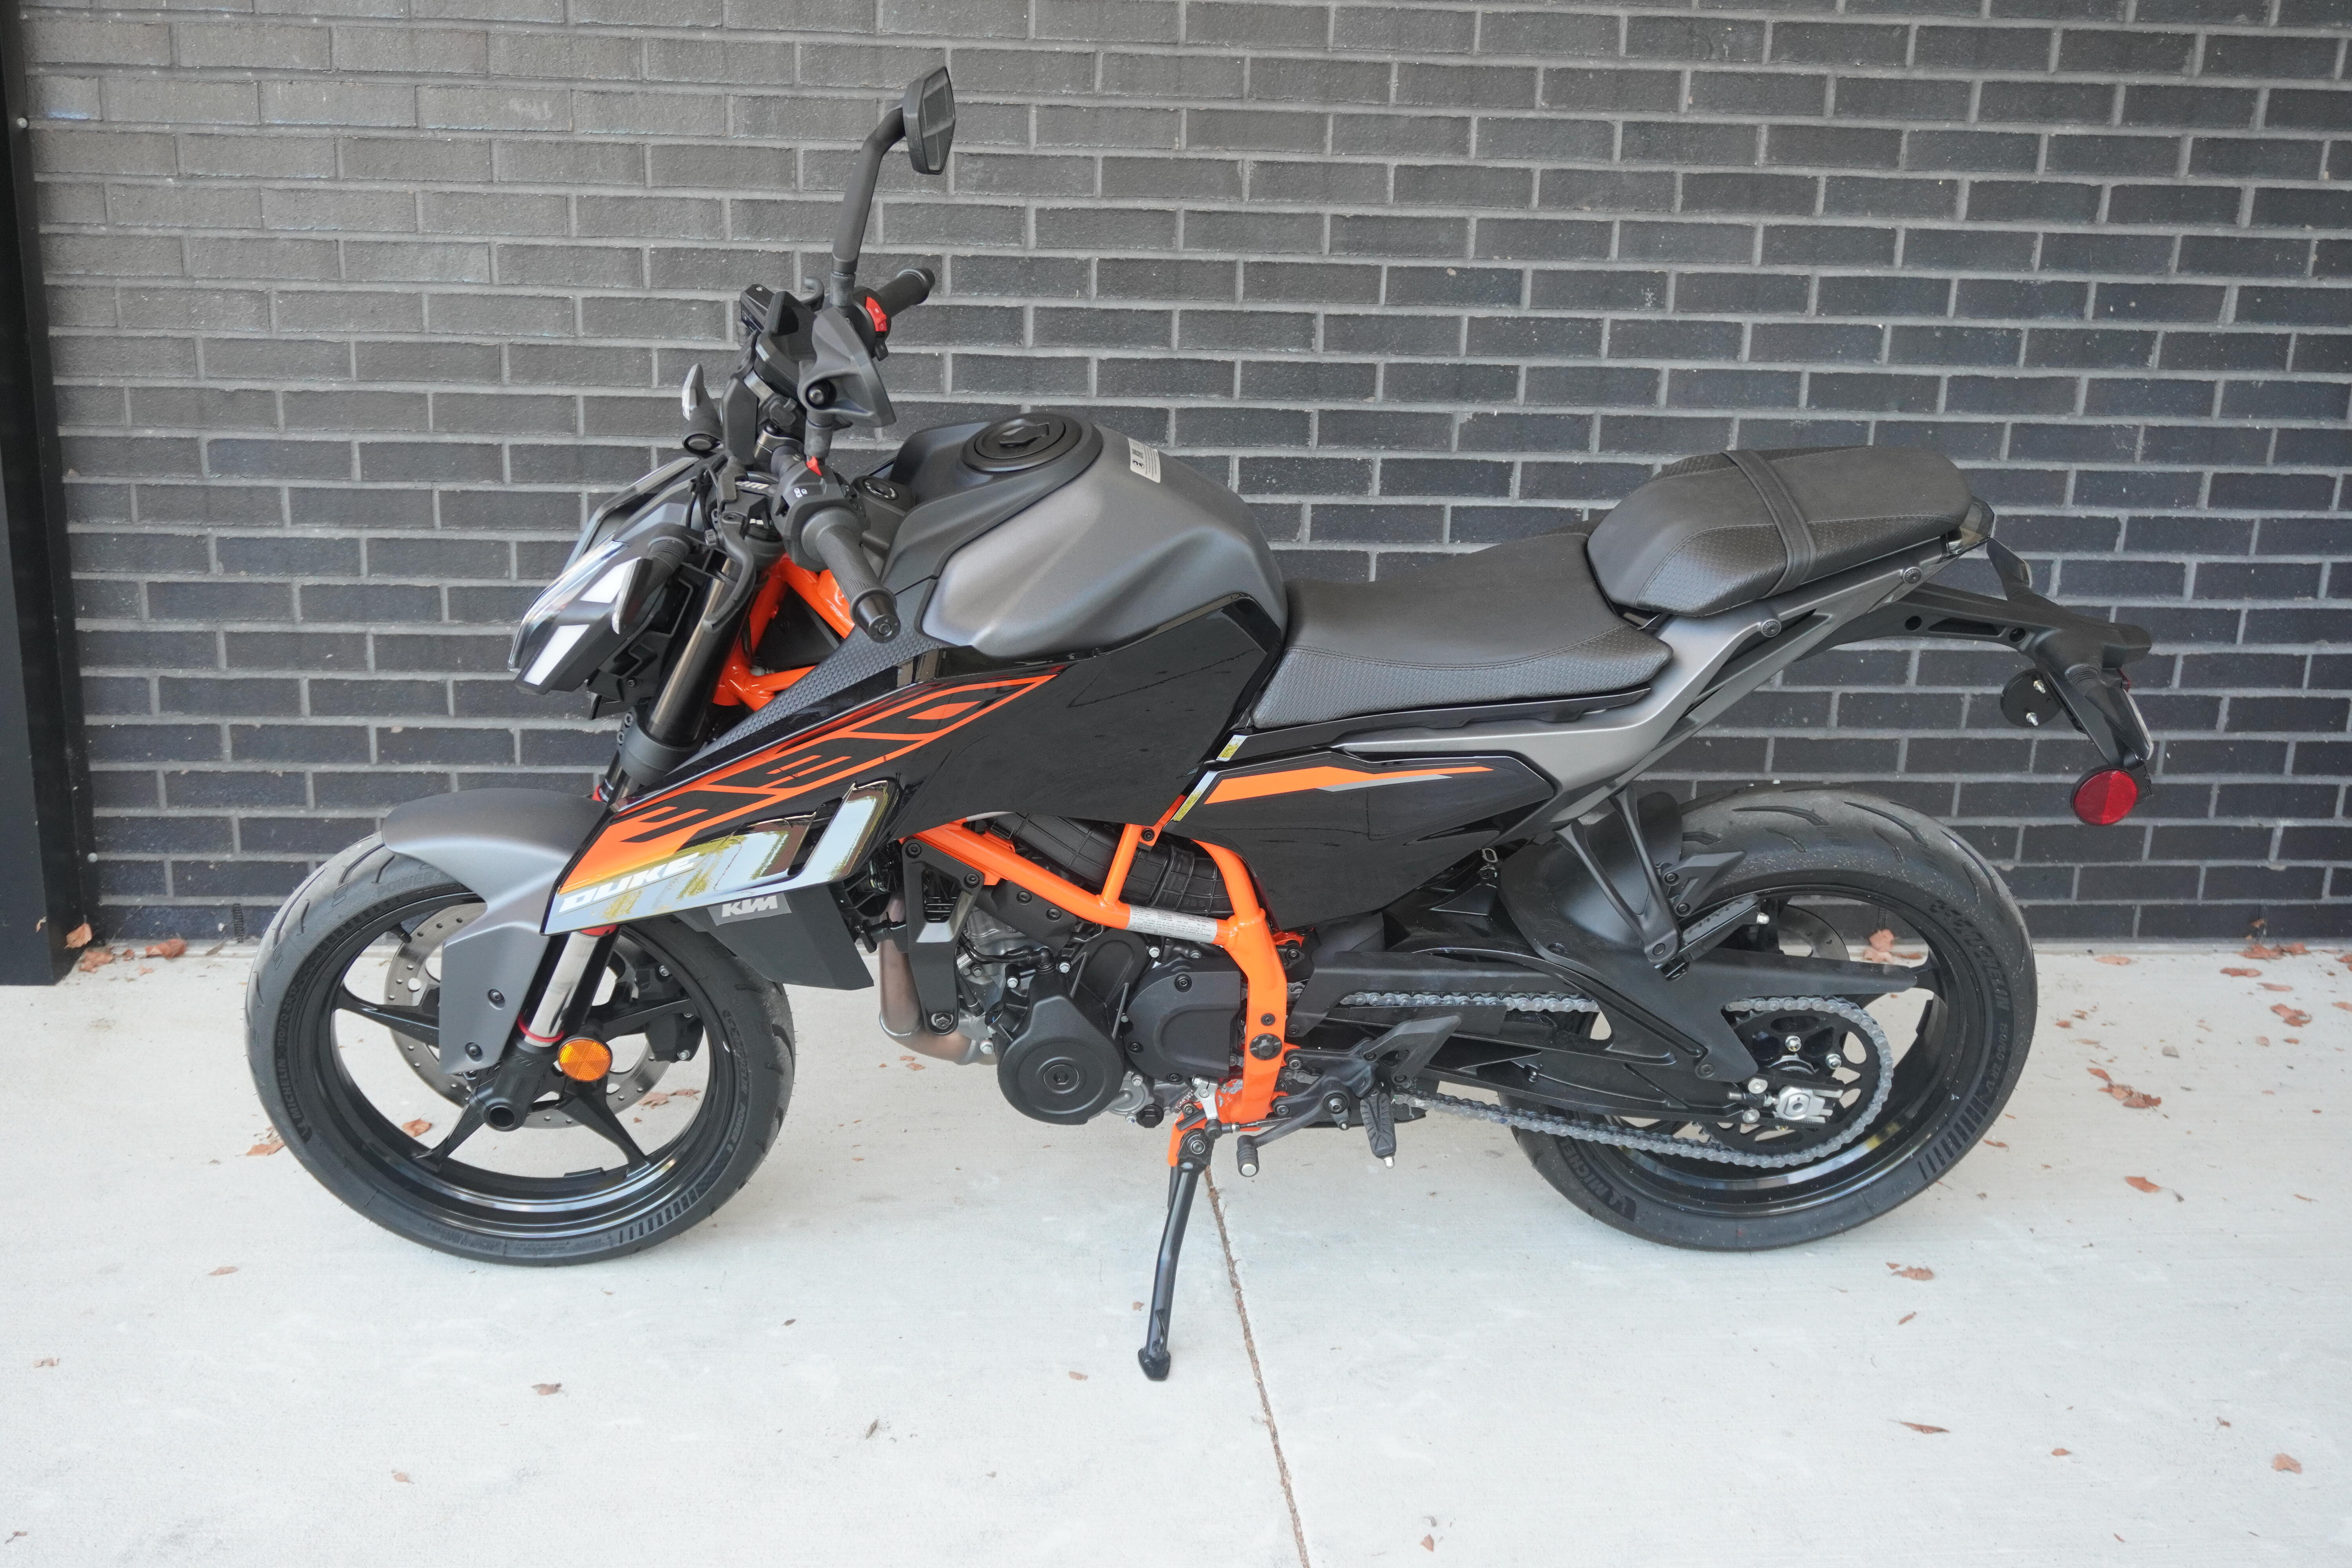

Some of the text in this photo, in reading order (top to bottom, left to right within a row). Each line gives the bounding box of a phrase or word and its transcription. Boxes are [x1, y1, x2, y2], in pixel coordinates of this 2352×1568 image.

[558, 852, 700, 913] DUKE
[722, 895, 777, 917] KTM
[277, 1059, 302, 1119] MICHELIN
[1561, 1138, 1609, 1196] MICHEL
